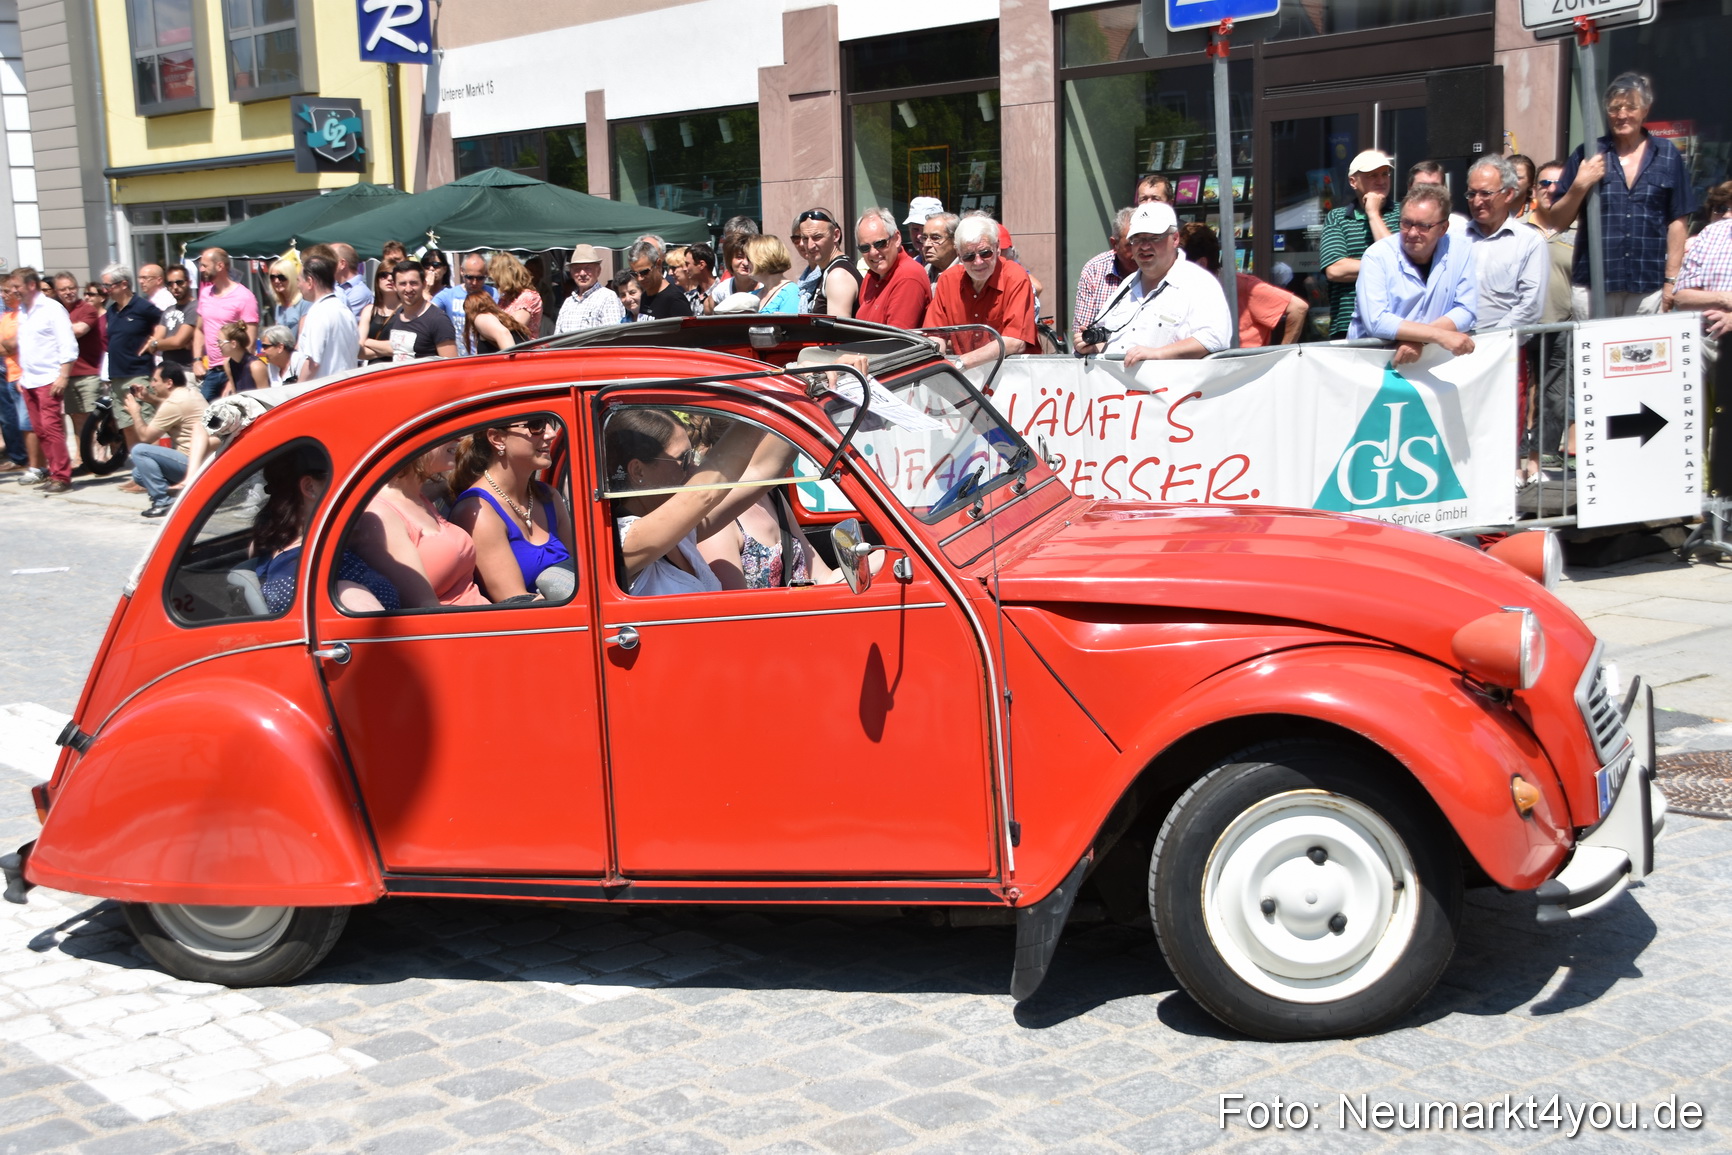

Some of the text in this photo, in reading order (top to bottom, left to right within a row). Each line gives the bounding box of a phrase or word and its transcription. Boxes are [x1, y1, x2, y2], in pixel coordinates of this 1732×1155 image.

[441, 80, 494, 102] Unterer Markt 15
[1582, 341, 1597, 505] RESIDENZPLATZ
[1681, 331, 1695, 494] RESIDENZPLATZ
[1391, 511, 1431, 526] Service
[1435, 505, 1468, 522] GmbH
